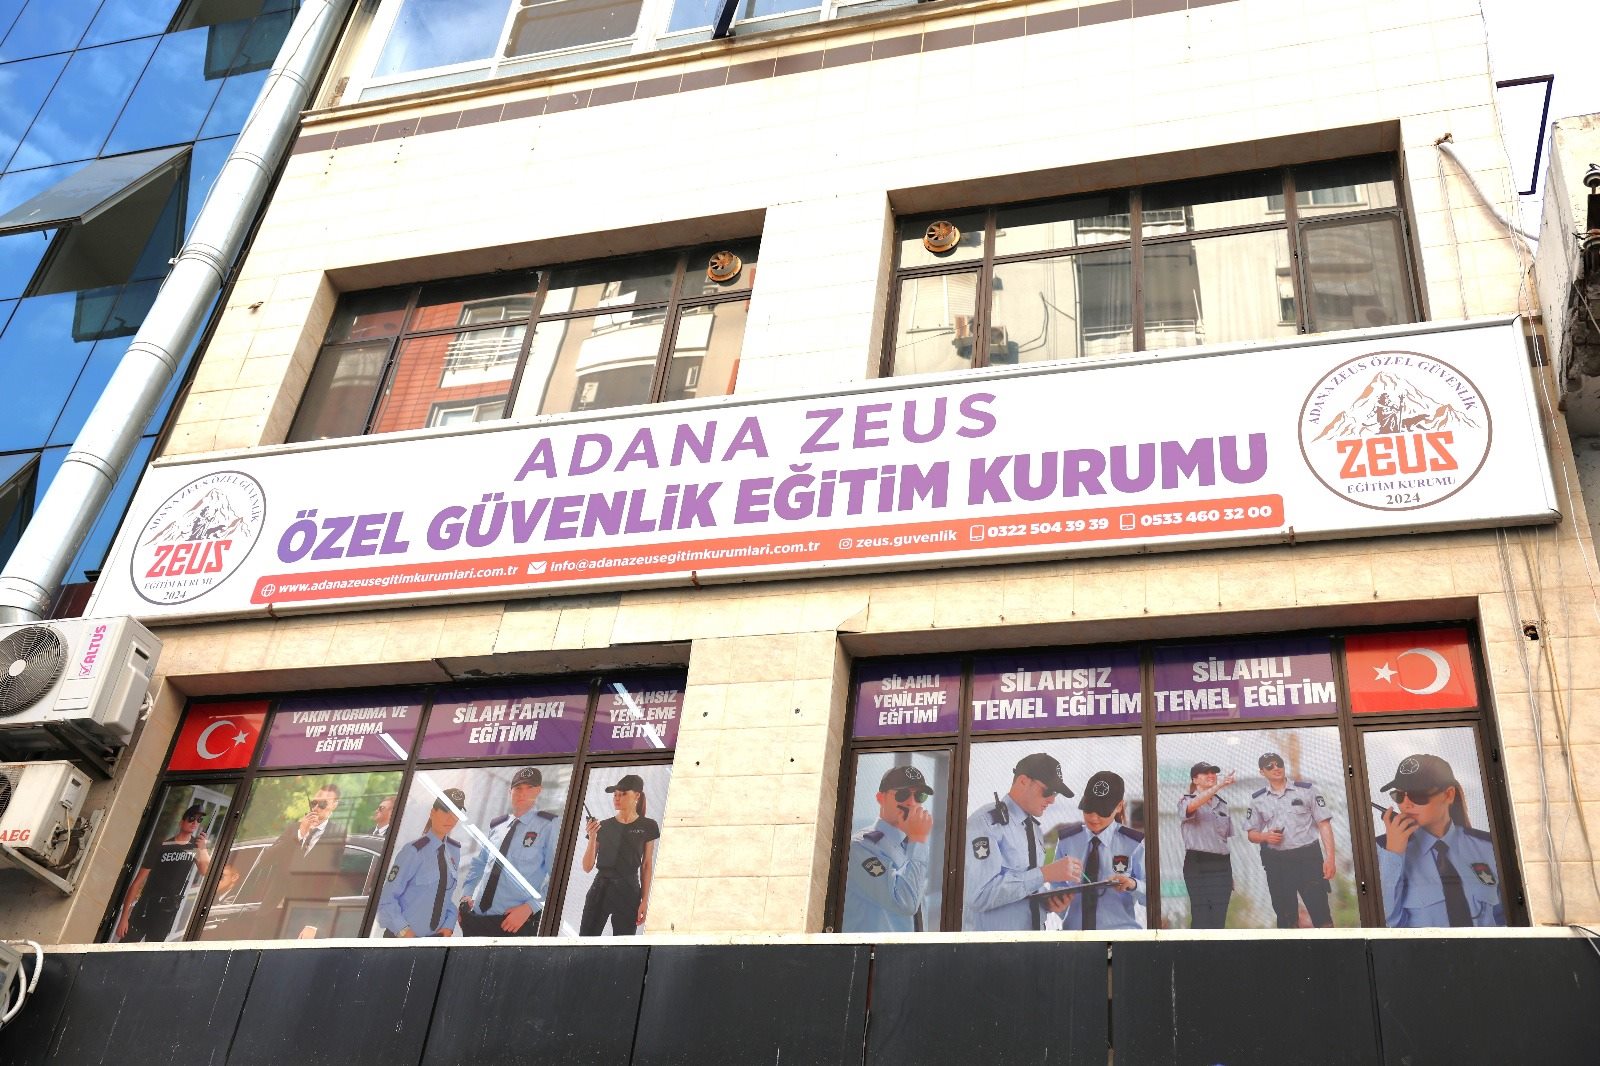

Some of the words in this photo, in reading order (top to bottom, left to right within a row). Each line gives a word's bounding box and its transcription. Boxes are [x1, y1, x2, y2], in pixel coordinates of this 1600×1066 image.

[1308, 386, 1335, 425] ADANA
[1331, 362, 1368, 386] ZEUS
[1371, 356, 1414, 368] ÖZEL
[1418, 361, 1478, 411] GÜVENLİK
[515, 416, 768, 482] ADANA
[799, 393, 996, 453] ZEUS
[1337, 431, 1458, 479] ZEUS
[1347, 479, 1395, 494] EĞİTİM
[1398, 476, 1456, 490] KURUMU
[277, 509, 410, 564] ÖZEL
[427, 482, 721, 550] GÜVENLİK
[735, 463, 949, 523] EĞİTİM
[968, 432, 1268, 504] KURUMU
[1385, 493, 1421, 505] 2024
[1140, 513, 1183, 527] 0533
[1186, 510, 1220, 523] 460
[1223, 507, 1245, 520] 32
[1247, 505, 1272, 518] 00
[987, 524, 1026, 538] 0322
[1029, 522, 1062, 535] 504
[1065, 519, 1086, 532] 39
[1088, 517, 1109, 531] 39
[855, 529, 957, 549] zeus.guvenlik
[145, 540, 232, 578] ZEUS
[278, 565, 519, 593] www.adanazeusegitimkurumlari.com.tr
[84, 624, 106, 664] ALTUS
[1000, 667, 1112, 693] SİLAHSIZ
[1192, 656, 1292, 683] SİLAHLI
[881, 674, 940, 690] SİLAHLI
[613, 690, 678, 706] SAHSIZ
[873, 690, 947, 708] YENİLEME
[972, 697, 1048, 721] TEMEL
[1056, 689, 1141, 717] EĞİTİM
[1154, 688, 1237, 712] TEMEL
[1243, 678, 1336, 708] EĞİTİM
[292, 710, 331, 724] YAKIN
[331, 706, 387, 722] KORUMA
[391, 706, 408, 719] VE
[453, 703, 508, 724] SİLAH
[508, 701, 565, 721] FARKI
[879, 706, 938, 726] EĞİTİMİ
[305, 725, 326, 738] VIP
[328, 722, 383, 737] KORUMA
[469, 720, 539, 744] EĞİTİMİ
[315, 735, 365, 752] EĞİTİMİ
[0, 829, 31, 842] AEG
[161, 851, 196, 863] SECURITY
